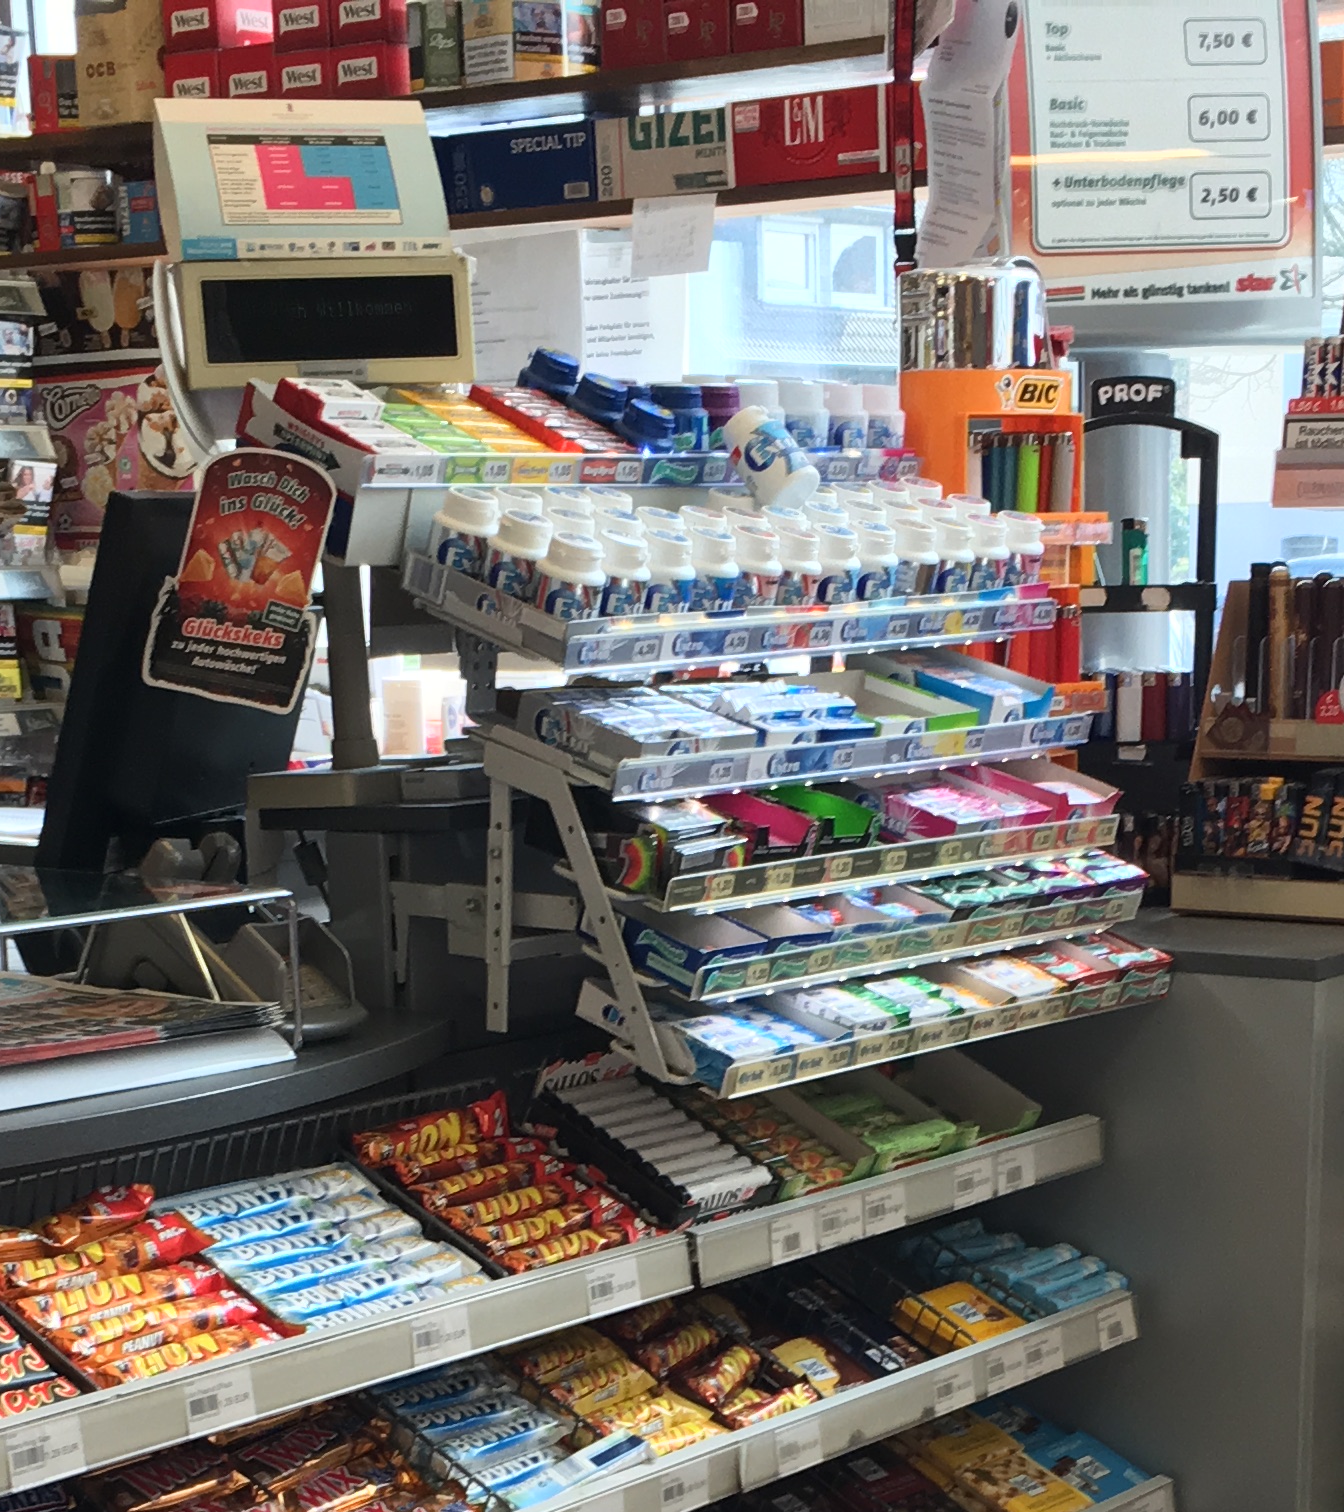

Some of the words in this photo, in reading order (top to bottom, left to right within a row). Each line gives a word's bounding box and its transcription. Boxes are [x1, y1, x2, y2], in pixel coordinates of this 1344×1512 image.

[175, 11, 206, 28] West
[284, 9, 315, 26] West
[343, 2, 377, 20] West
[1045, 22, 1069, 38] Top
[1197, 32, 1235, 51] 7,50
[1241, 32, 1253, 47] €
[86, 62, 116, 78] OCB
[286, 67, 318, 84] West
[342, 60, 374, 78] West
[177, 81, 207, 97] West
[233, 74, 264, 90] West
[1049, 96, 1086, 113] Basic
[784, 96, 825, 146] L&M
[1198, 109, 1239, 129] 6,00
[1246, 109, 1258, 125] €
[510, 133, 563, 154] SPECIAL
[564, 132, 586, 149] TIP
[600, 165, 613, 198] 200
[1064, 174, 1187, 193] Unterbodenpflege
[1200, 187, 1239, 207] 2,50
[1246, 187, 1258, 202] €
[1091, 287, 1120, 301] Mehr
[1142, 285, 1184, 301] günstig
[1187, 281, 1230, 295] tanken!
[1235, 273, 1276, 292] star
[1019, 381, 1057, 405] BIC
[1097, 382, 1164, 406] PROF
[228, 471, 277, 489] Wasch
[280, 476, 310, 503] Dich
[219, 496, 247, 516] ins
[251, 493, 306, 530] Glück!
[182, 616, 286, 650] Glückskeks
[56, 1276, 142, 1320] LION
